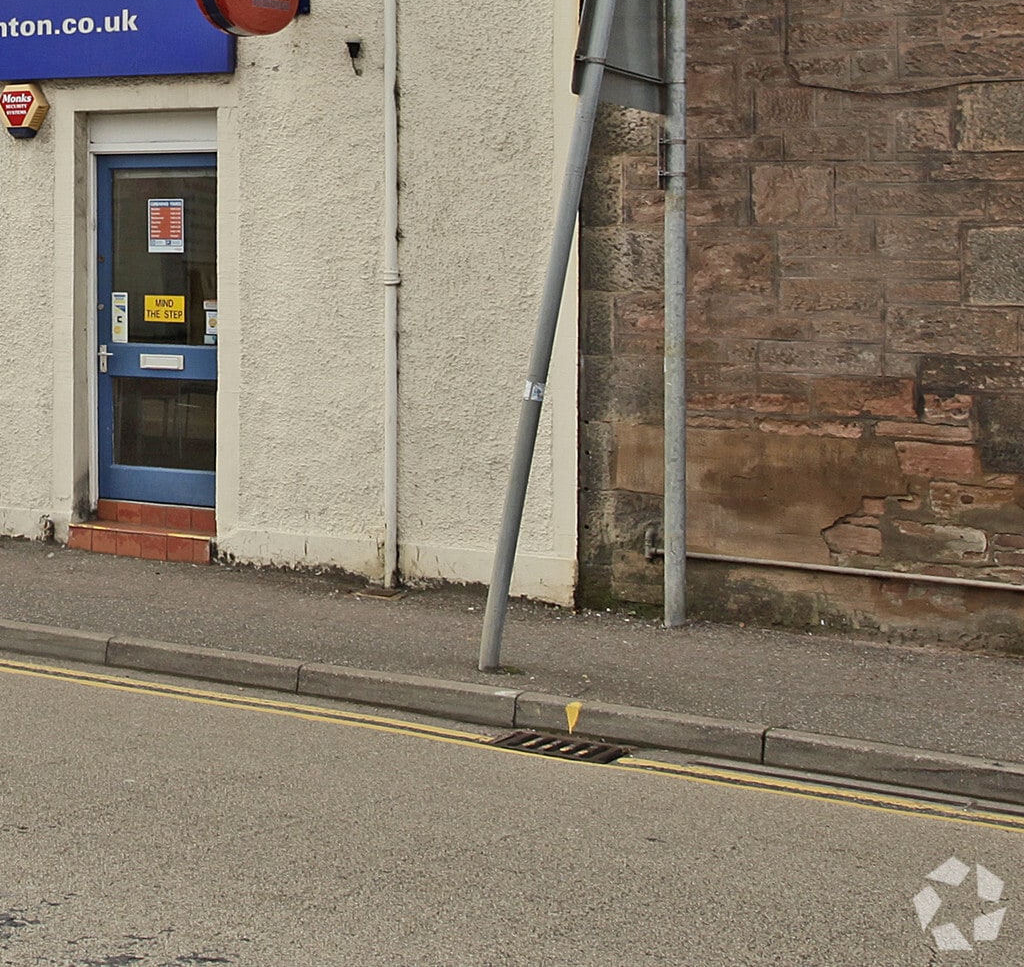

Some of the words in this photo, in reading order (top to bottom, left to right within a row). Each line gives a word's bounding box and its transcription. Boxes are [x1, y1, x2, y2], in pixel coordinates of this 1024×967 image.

[2, 93, 32, 103] Monks
[155, 299, 174, 307] MIND
[147, 310, 160, 318] THE
[164, 310, 183, 319] STEP
